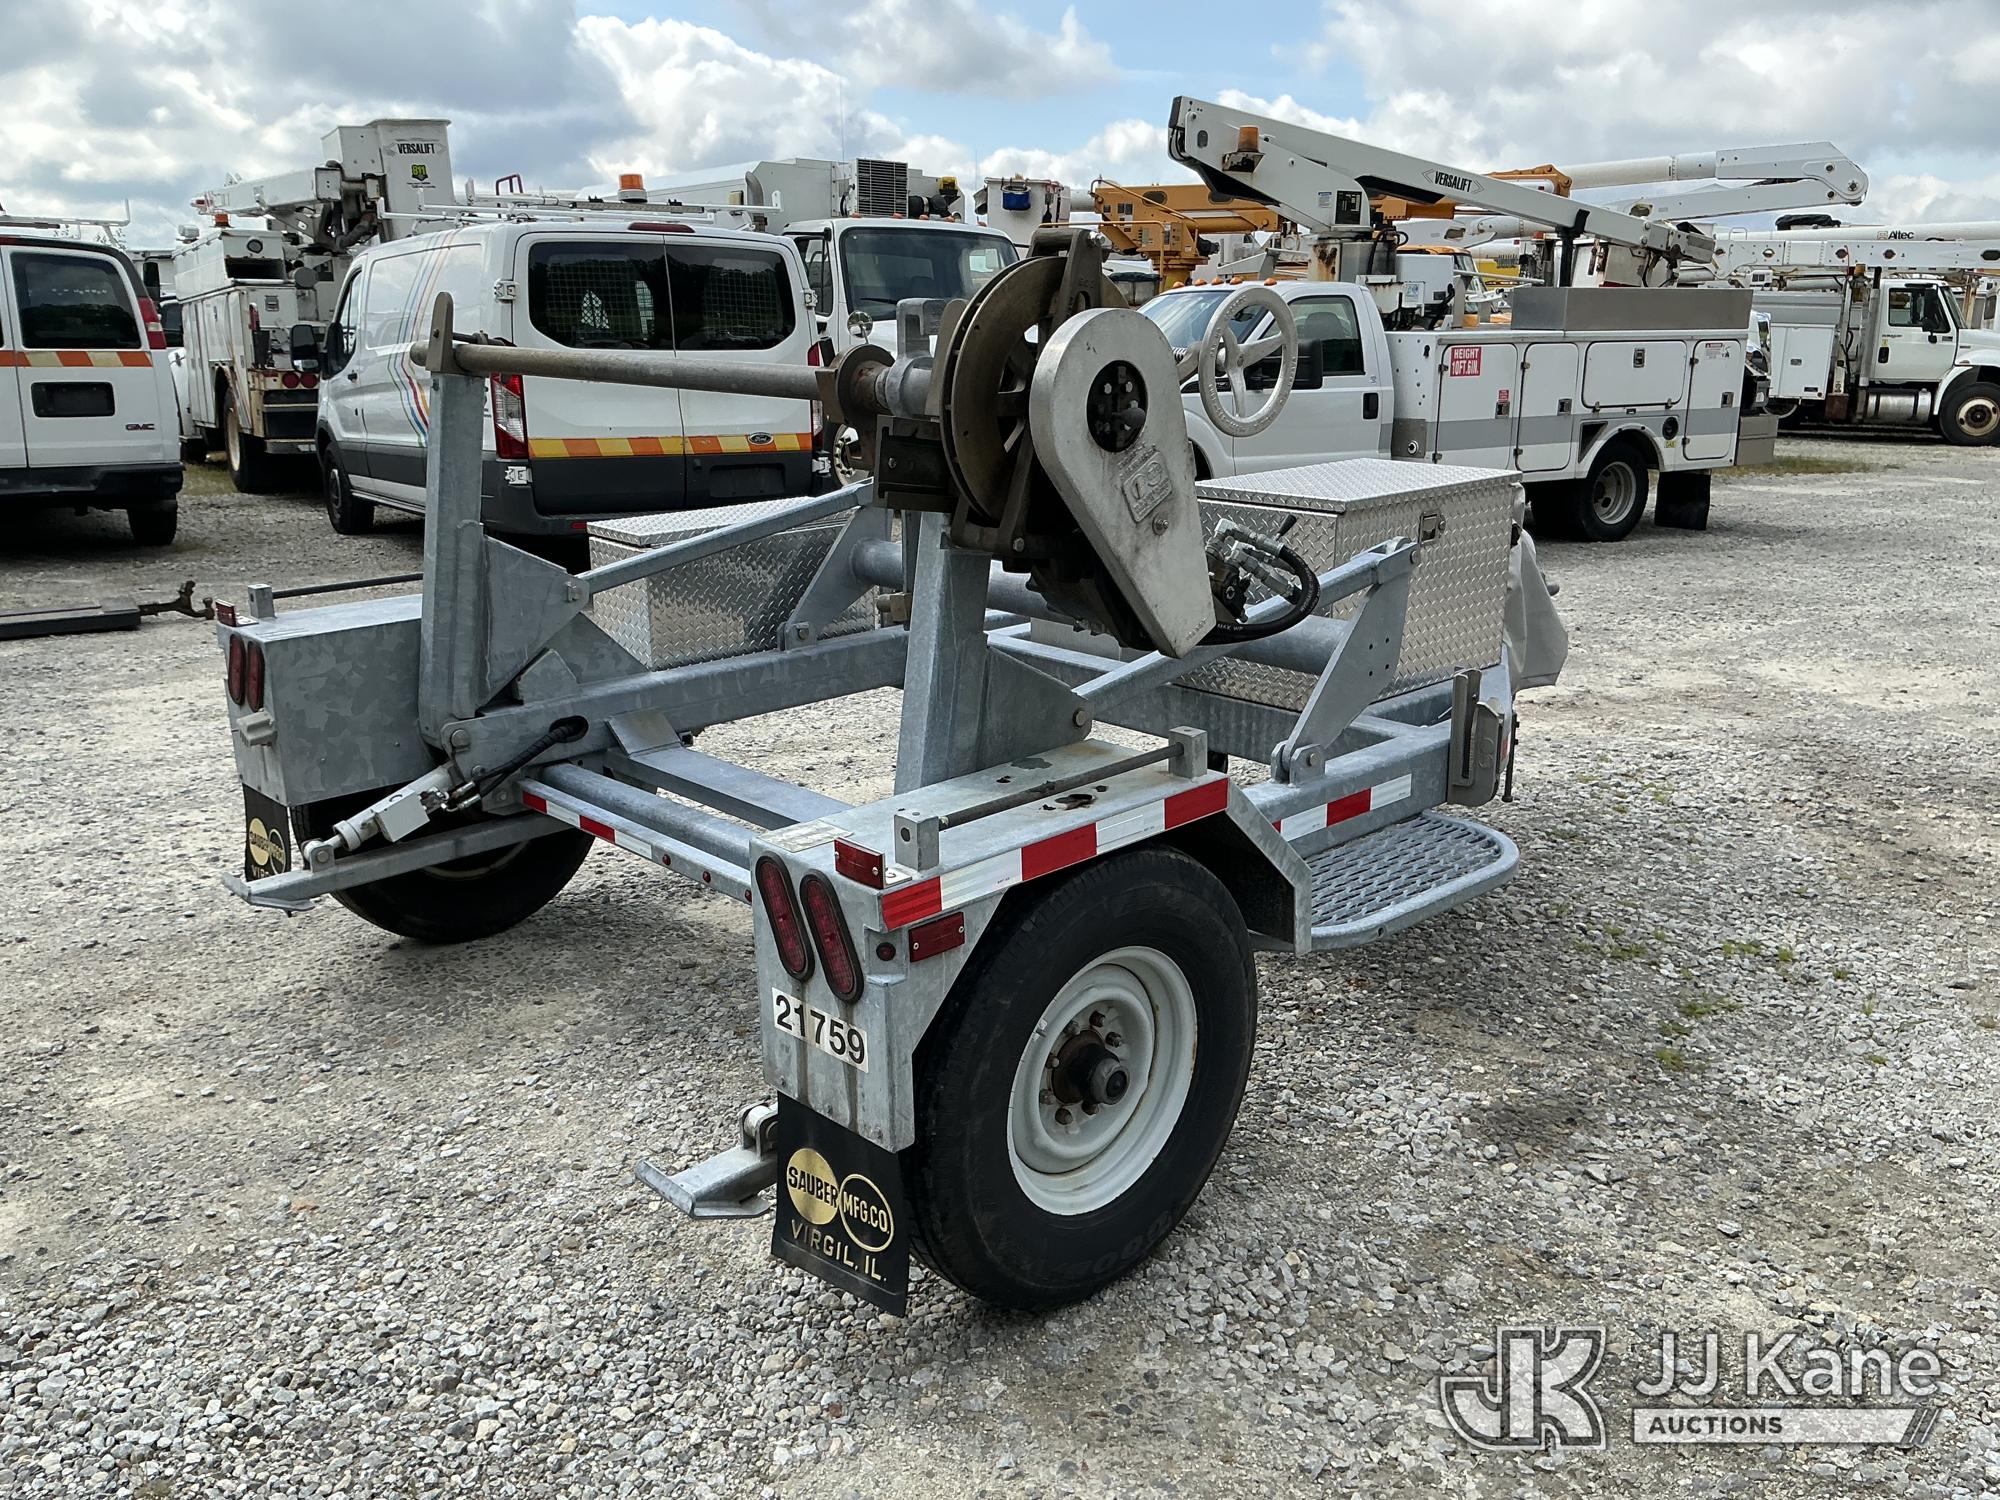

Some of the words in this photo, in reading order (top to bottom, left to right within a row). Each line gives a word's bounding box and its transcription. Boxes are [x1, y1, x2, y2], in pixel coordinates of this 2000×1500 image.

[397, 143, 435, 154] VERSALIFT
[1434, 171, 1472, 192] VERSALIFT
[1888, 229, 1914, 240] Altec
[1453, 348, 1480, 360] HEIGHT
[125, 423, 155, 431] GMC
[775, 994, 865, 1065] 21759
[788, 1166, 839, 1208] SAUBER
